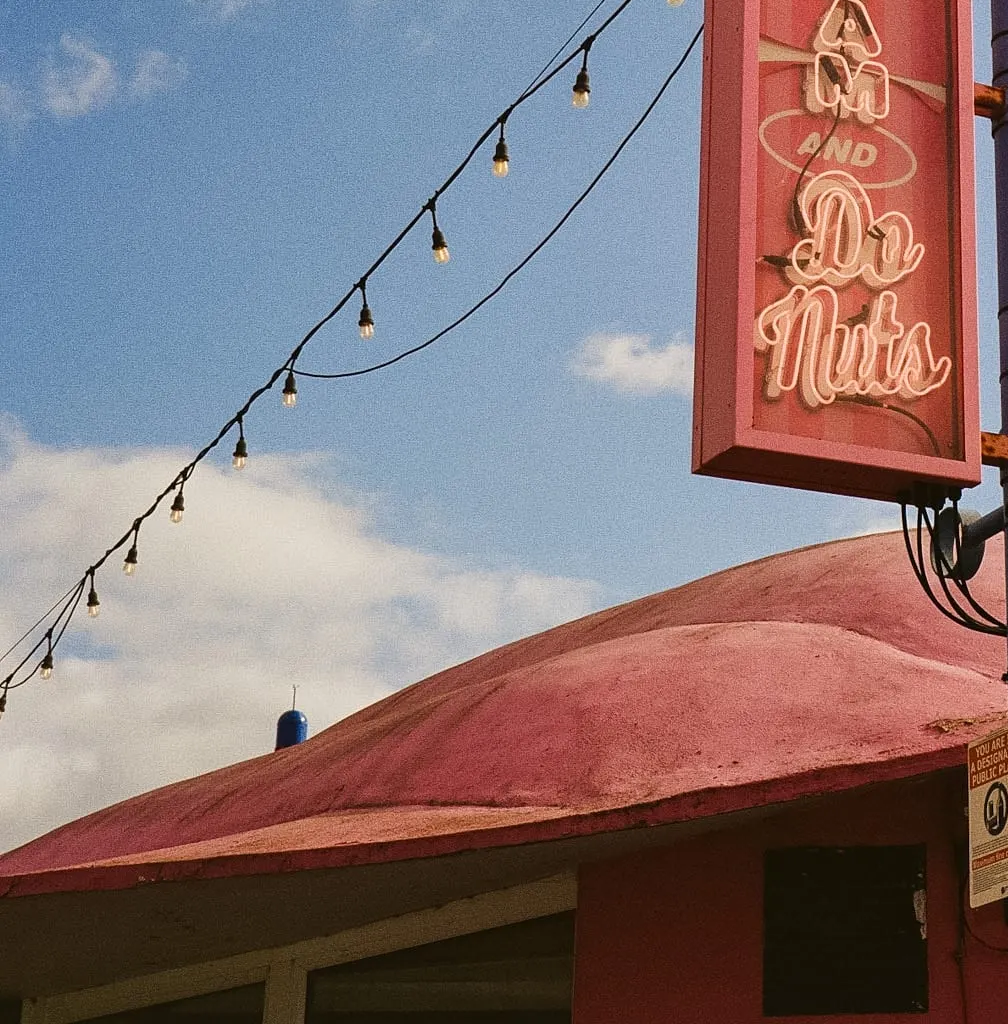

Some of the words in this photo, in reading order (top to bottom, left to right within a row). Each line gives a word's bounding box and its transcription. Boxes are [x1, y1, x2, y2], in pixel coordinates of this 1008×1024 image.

[796, 131, 878, 168] AND
[793, 170, 925, 284] Do
[756, 285, 953, 405] Nuts
[975, 741, 990, 758] YOU
[991, 735, 1006, 752] ARE
[970, 761, 976, 774] A
[972, 765, 997, 787] PUBLIC
